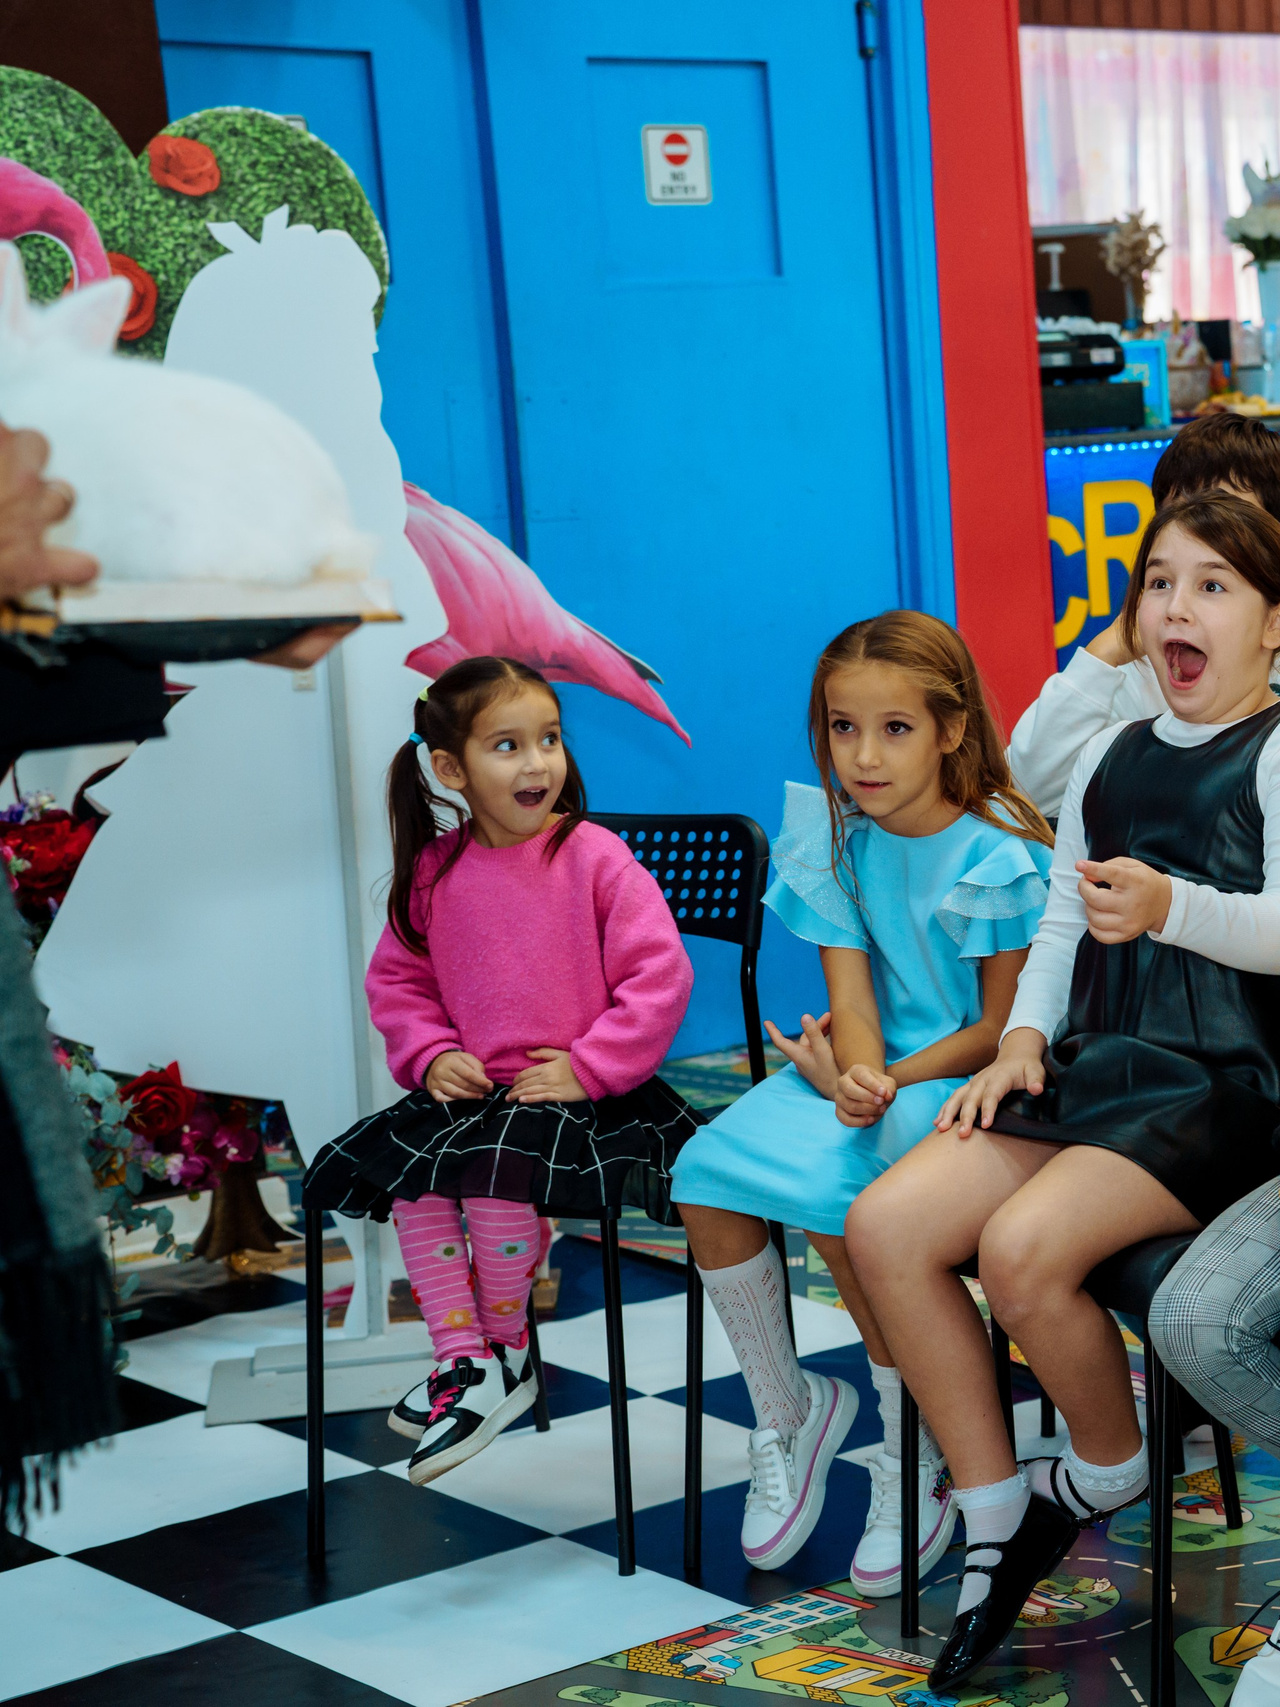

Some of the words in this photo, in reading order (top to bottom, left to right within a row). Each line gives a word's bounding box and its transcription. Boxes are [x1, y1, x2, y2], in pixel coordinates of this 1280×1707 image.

[670, 171, 687, 182] NO
[661, 184, 698, 197] ENTRY
[878, 1649, 932, 1666] POLICE
